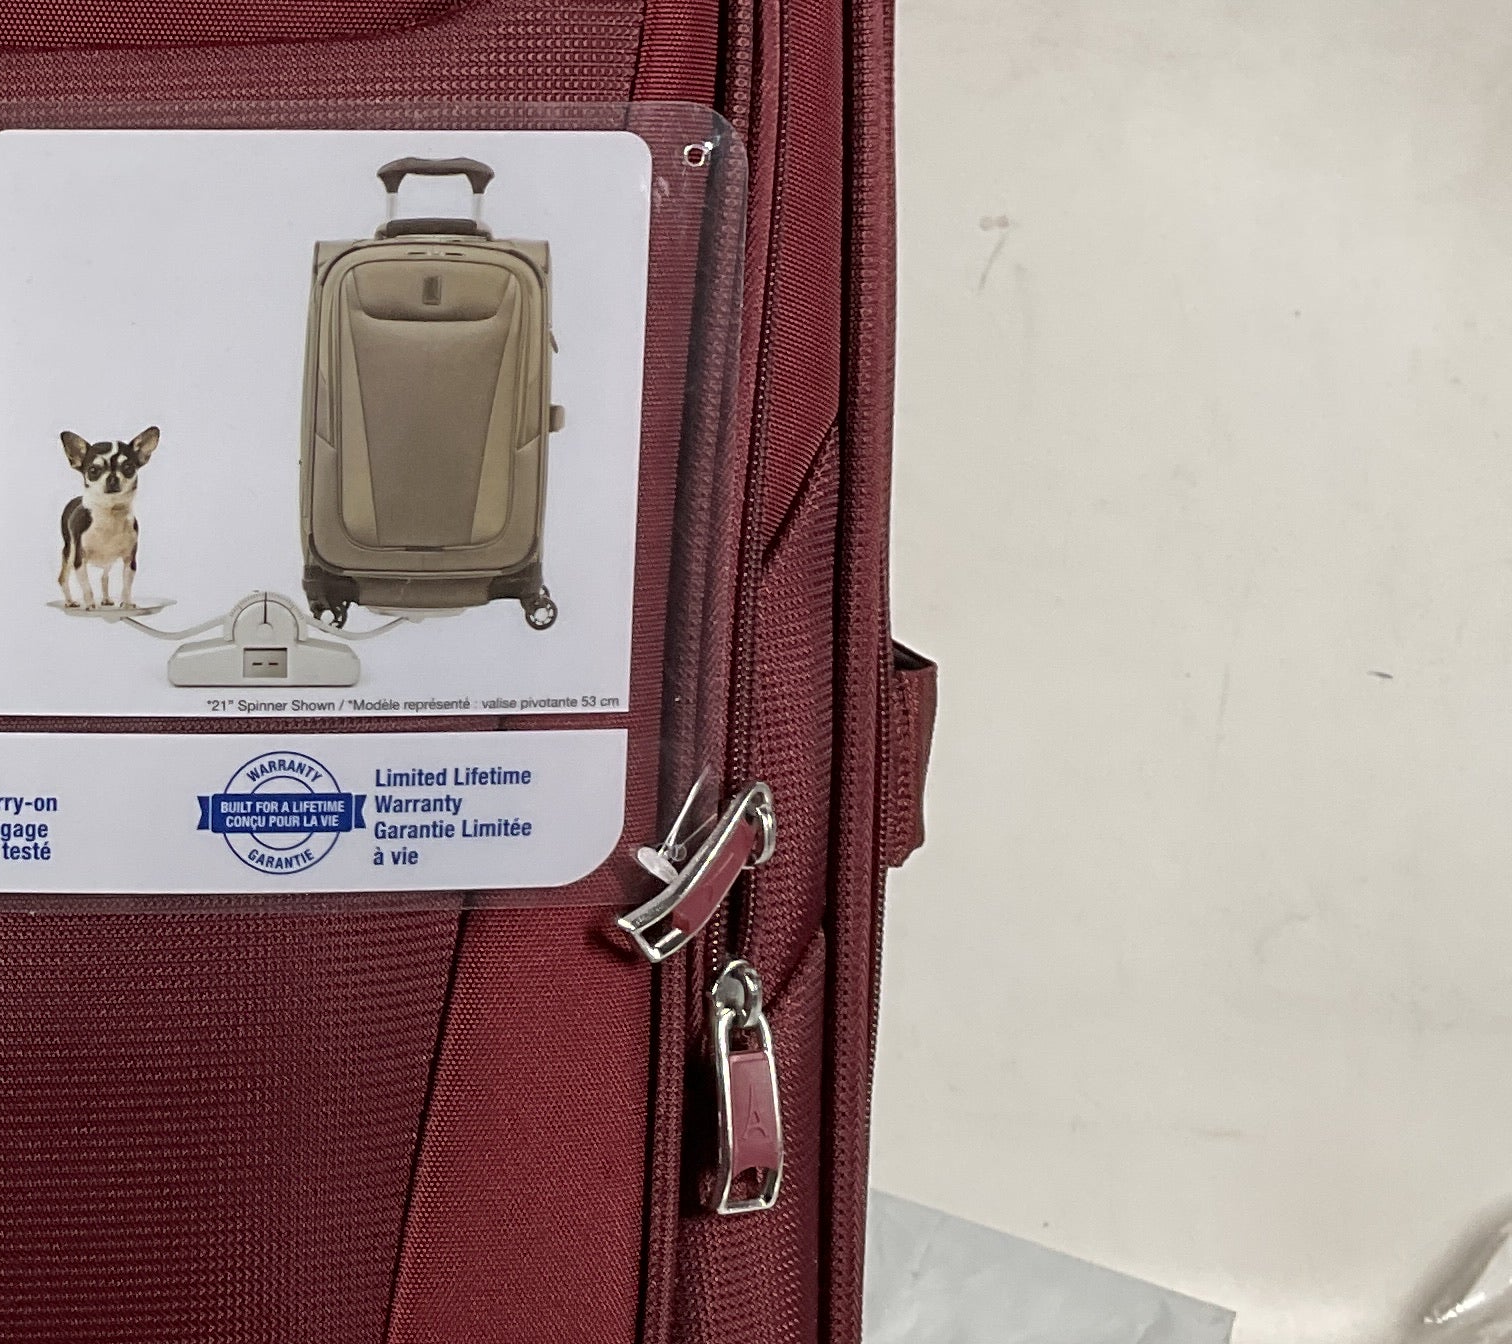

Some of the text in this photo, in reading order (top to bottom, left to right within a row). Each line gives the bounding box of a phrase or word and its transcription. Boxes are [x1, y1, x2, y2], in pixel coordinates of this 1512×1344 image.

[237, 699, 287, 714] Spinner
[291, 699, 335, 711] Shown
[338, 699, 345, 712] /
[403, 698, 471, 714] représenté
[481, 698, 517, 710] valise
[520, 696, 578, 711] pivotante
[581, 696, 597, 708] 53
[600, 699, 620, 707] cm
[246, 759, 323, 782] WARRANTY
[375, 766, 532, 788] Limited Lifetime
[220, 800, 345, 814] BUILT FOR A LIFETIME
[375, 794, 463, 816] Warranty
[225, 814, 339, 830] CONÇU POUR LA VIE
[374, 817, 533, 840] Garantie Limitée
[2, 841, 52, 861] testé
[247, 848, 315, 870] GARANTIE
[373, 846, 419, 866] à vie
